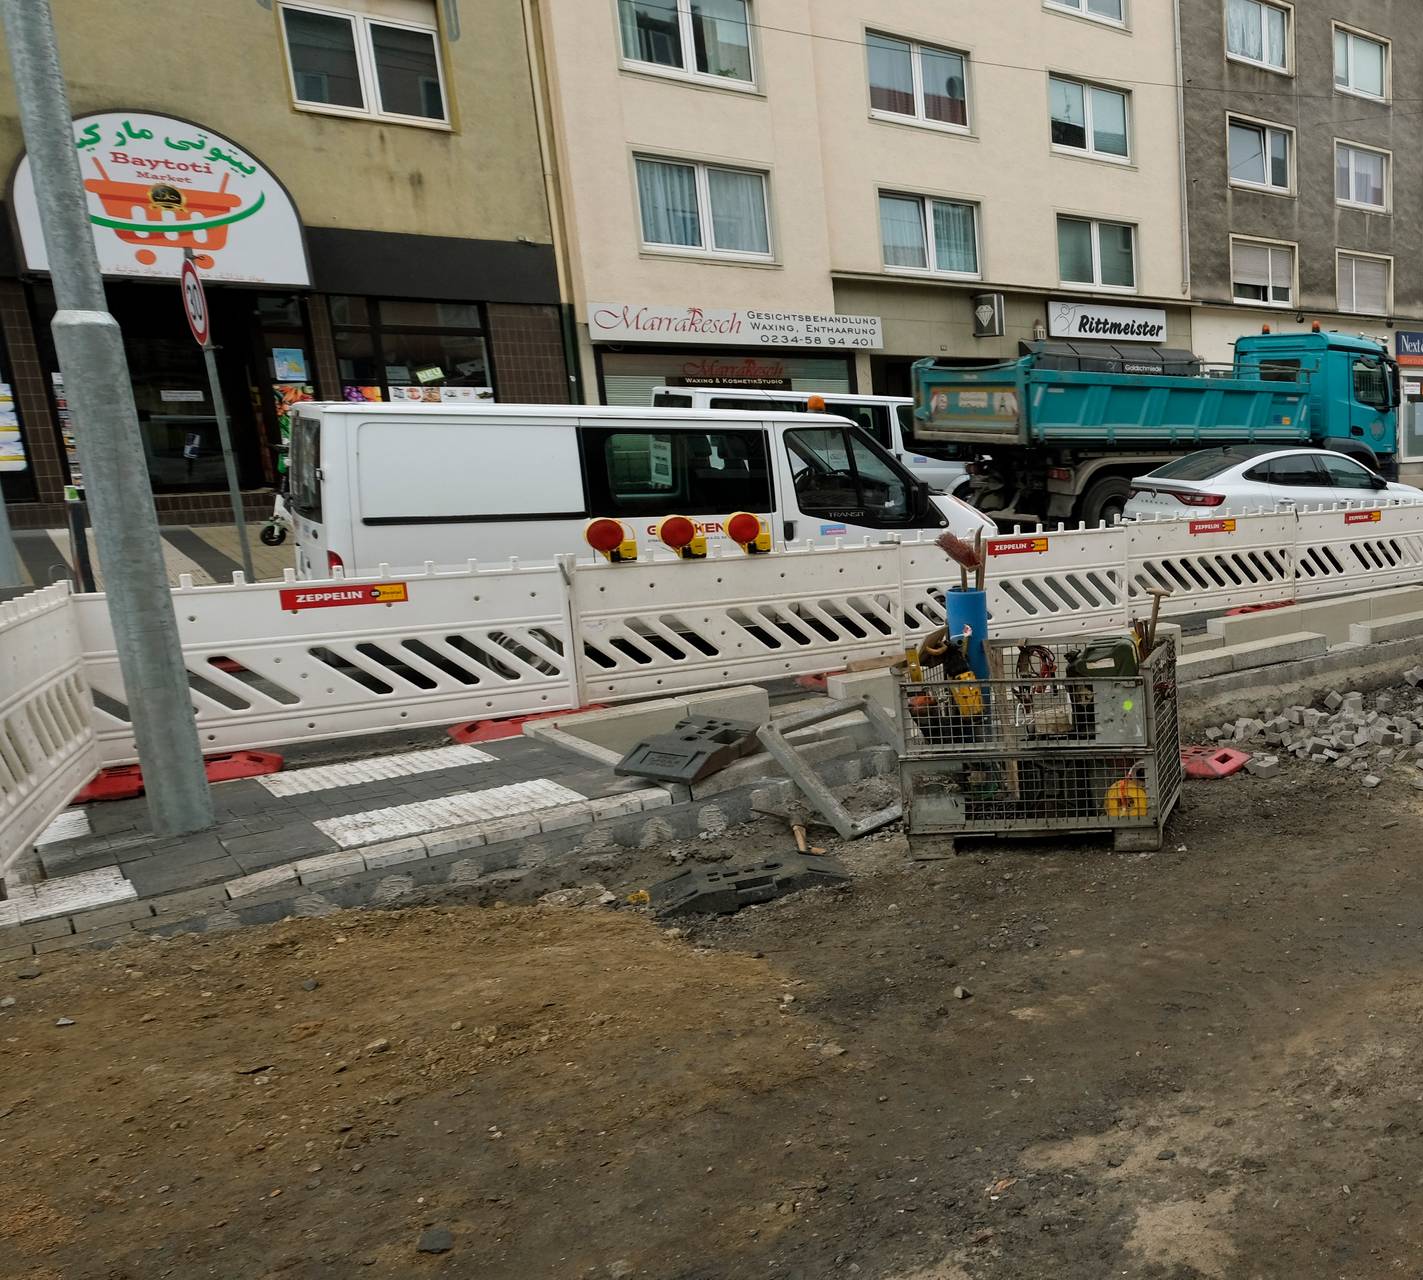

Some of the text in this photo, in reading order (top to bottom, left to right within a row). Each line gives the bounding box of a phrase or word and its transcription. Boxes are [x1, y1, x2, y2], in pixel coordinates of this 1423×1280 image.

[109, 151, 213, 174] Baytoti
[136, 170, 192, 184] Market
[187, 284, 203, 321] 30
[594, 305, 742, 334] Marrakesch
[1078, 314, 1164, 337] Rittmeister
[760, 334, 874, 347] 0234-58 94 401
[828, 511, 865, 519] TRANSIT
[994, 543, 1027, 551] ZEPPELIN
[296, 590, 363, 603] ZEPPELIN
